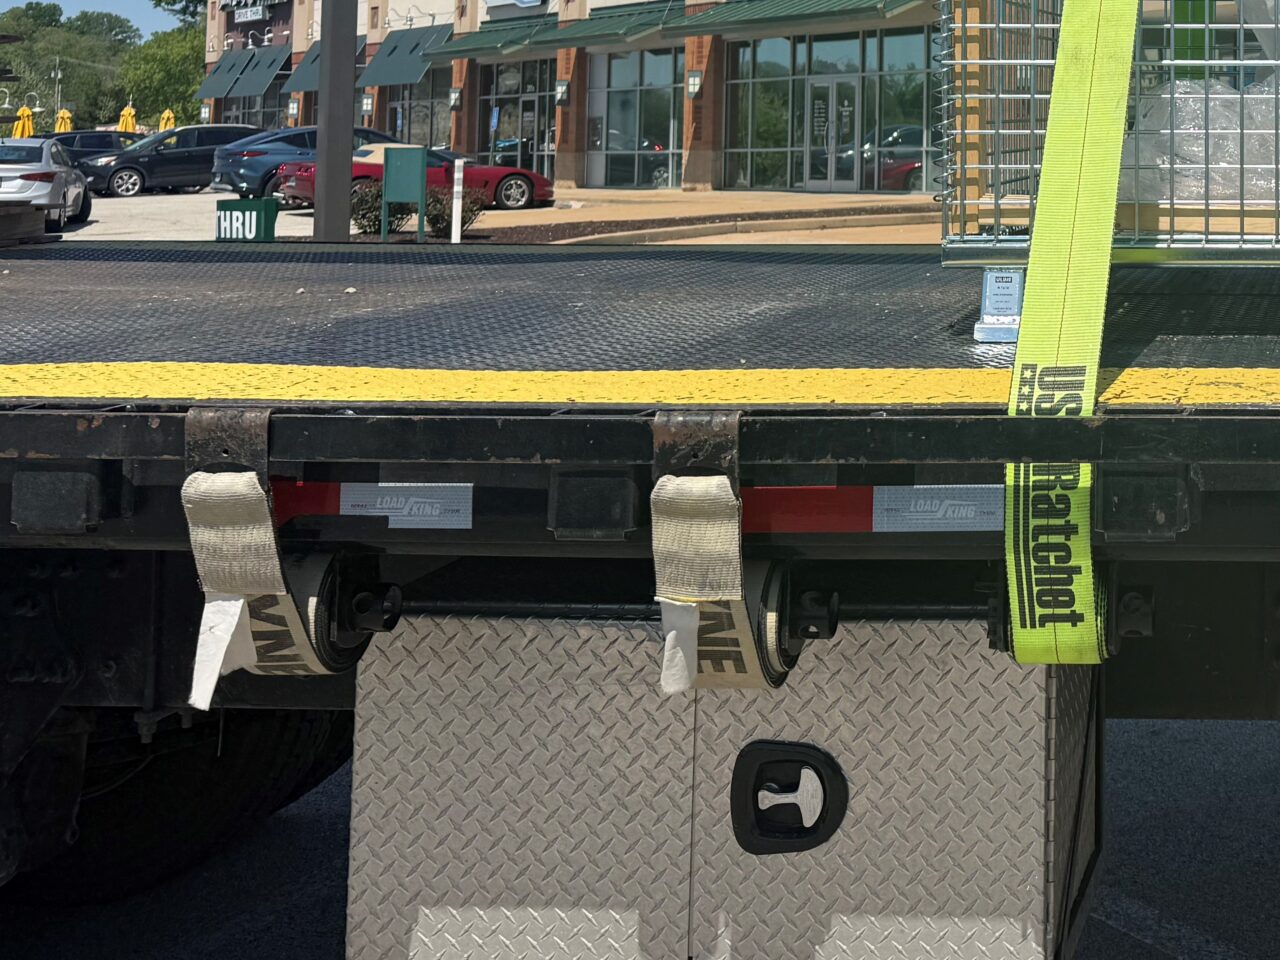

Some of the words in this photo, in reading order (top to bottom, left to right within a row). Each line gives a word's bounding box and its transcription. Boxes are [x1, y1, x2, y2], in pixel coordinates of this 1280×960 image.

[1034, 365, 1087, 417] US
[376, 496, 405, 509] LOAD
[410, 503, 440, 516] KING
[909, 500, 939, 512] LOAD
[945, 505, 976, 518] KING
[1030, 462, 1085, 628] Ratchet
